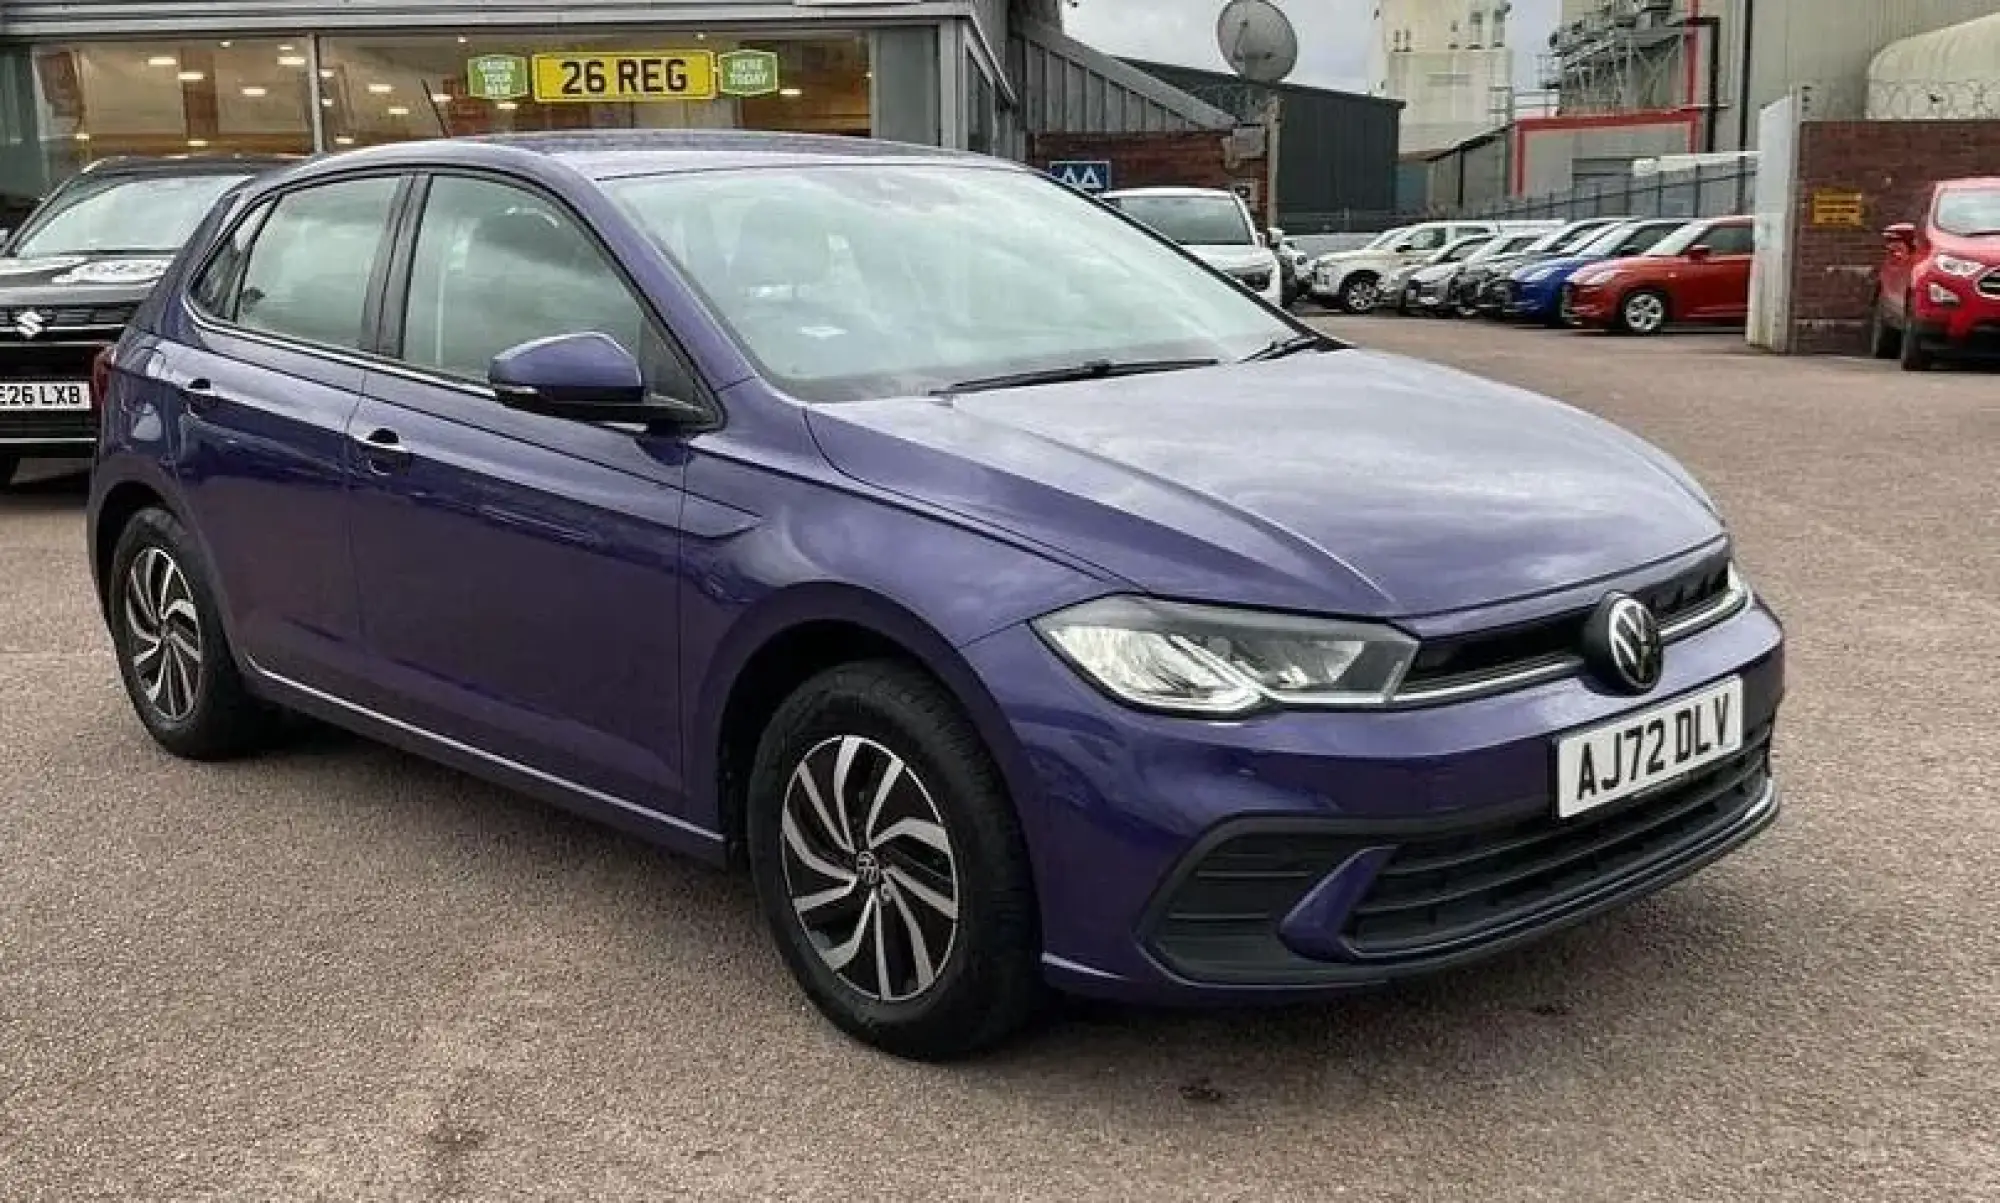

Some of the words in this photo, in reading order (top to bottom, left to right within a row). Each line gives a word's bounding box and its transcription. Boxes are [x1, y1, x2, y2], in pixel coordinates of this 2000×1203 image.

[562, 61, 606, 94] 26
[617, 59, 688, 94] REG
[40, 385, 81, 405] LXB
[1577, 718, 1664, 800] AJ72
[1675, 693, 1729, 763] DLV
